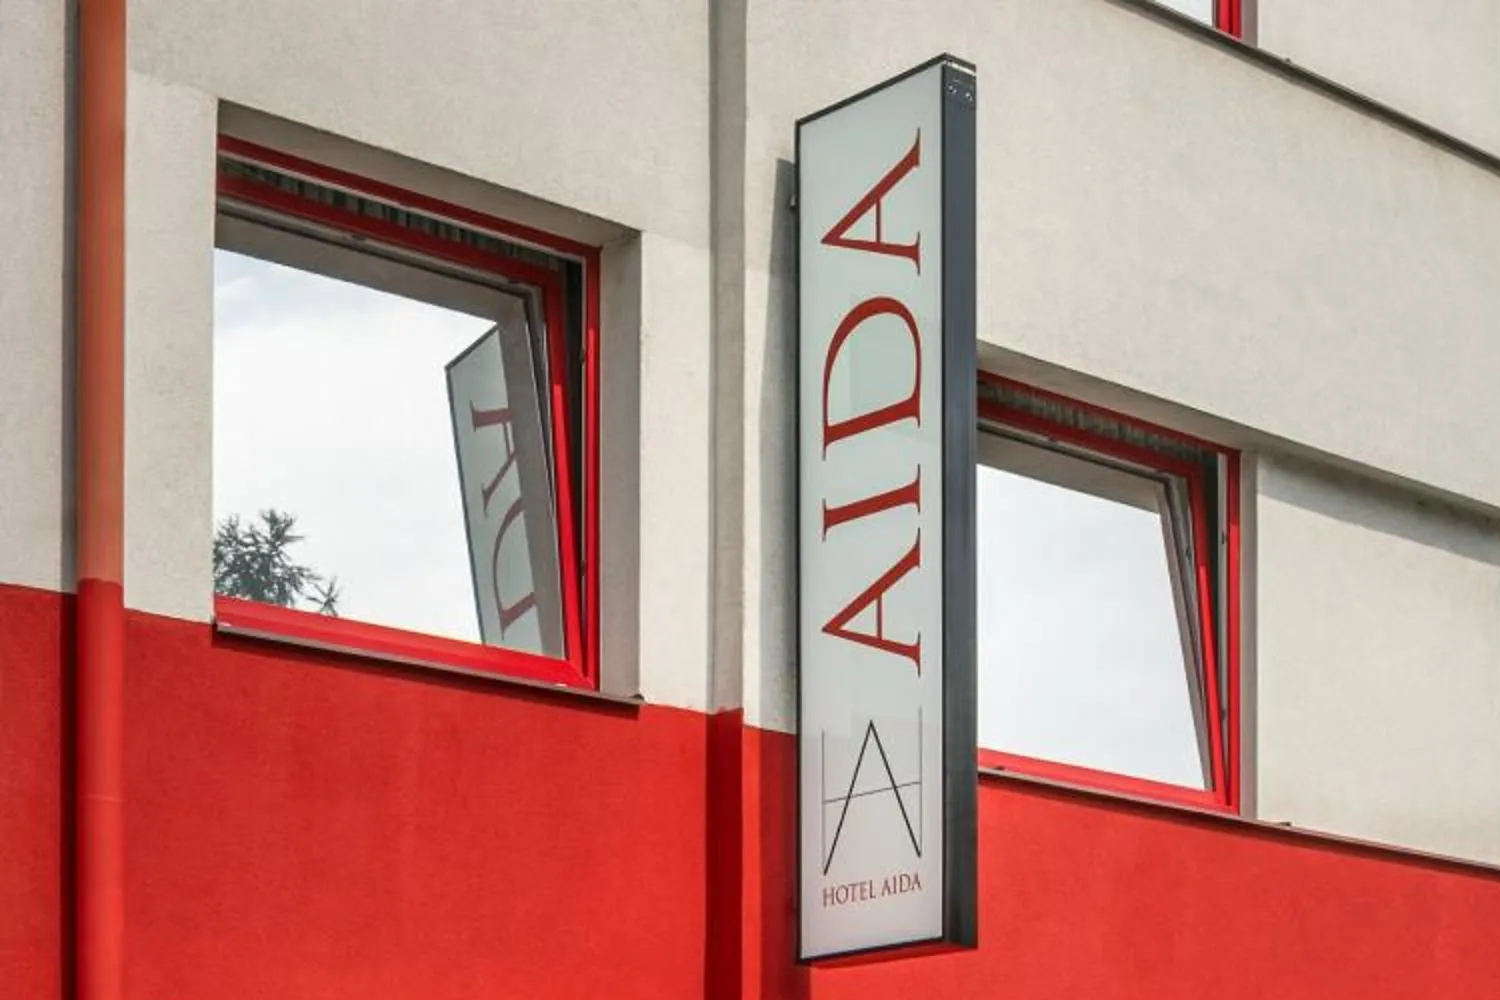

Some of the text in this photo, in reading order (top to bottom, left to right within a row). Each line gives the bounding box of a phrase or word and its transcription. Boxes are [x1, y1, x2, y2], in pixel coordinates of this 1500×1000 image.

[820, 126, 922, 678] AIDA
[822, 872, 922, 908] HOTEL AIDA
